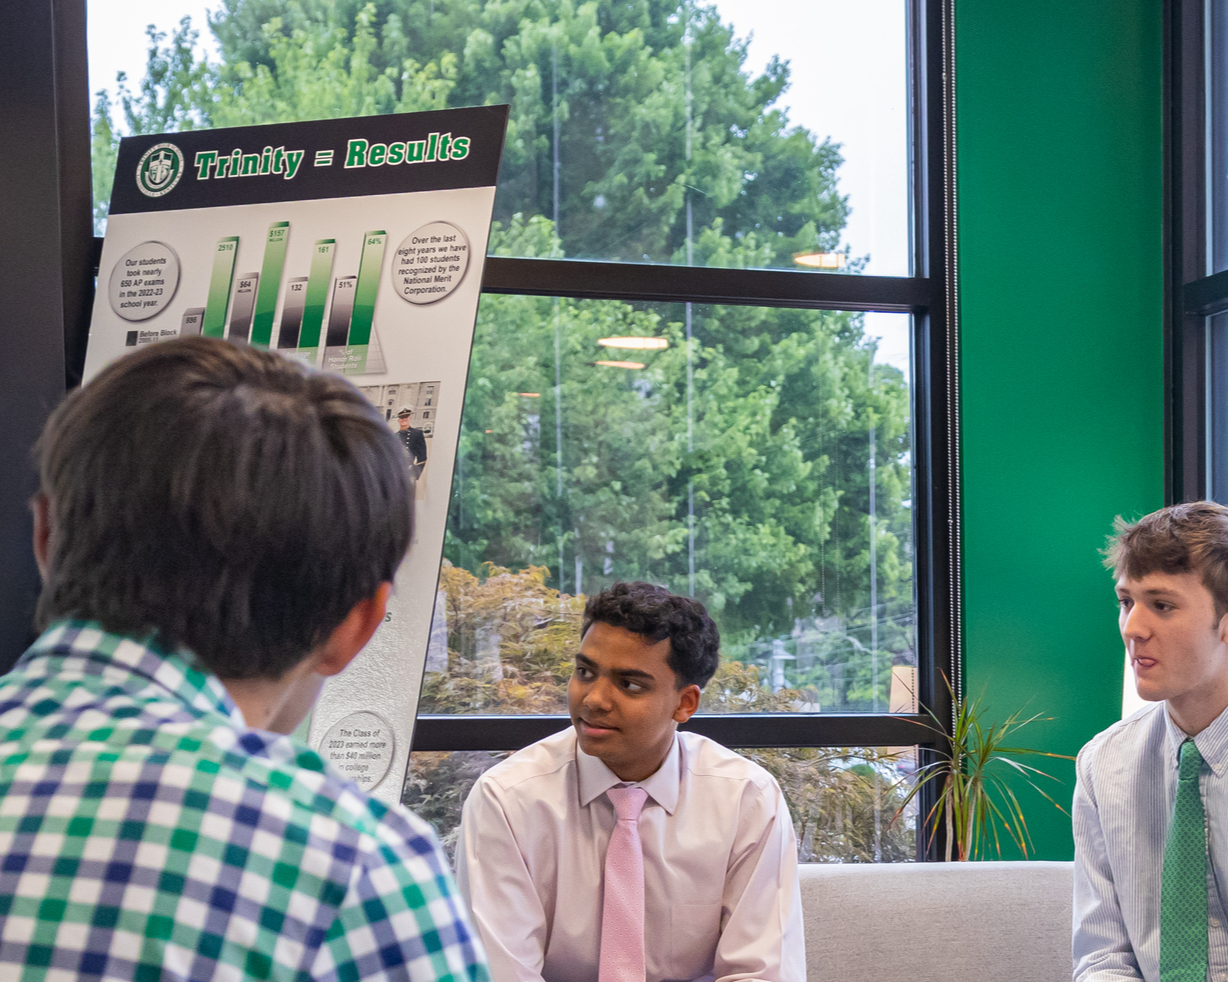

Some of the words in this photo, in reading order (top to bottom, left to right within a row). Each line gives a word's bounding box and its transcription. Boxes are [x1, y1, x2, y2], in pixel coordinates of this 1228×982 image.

[194, 145, 305, 180] Trinity
[314, 150, 334, 167] =
[344, 132, 471, 169] Results
[411, 236, 429, 245] Over
[430, 235, 442, 243] the
[443, 234, 456, 242] last
[218, 243, 234, 252] 2510
[398, 248, 416, 257] eight
[417, 246, 436, 256] years
[125, 258, 138, 267] Our
[138, 257, 167, 266] students
[401, 257, 414, 265] had
[416, 256, 428, 264] 100
[429, 255, 460, 263] students
[126, 269, 141, 277] took
[142, 268, 162, 276] nearly
[398, 265, 437, 276] recognized
[438, 265, 447, 274] by
[448, 264, 460, 272] the
[133, 279, 143, 287] AP
[338, 281, 353, 289] 51%
[403, 276, 432, 285] National
[126, 290, 137, 298] the
[138, 288, 163, 297] 2022-23
[403, 285, 447, 295] Corporation.
[120, 300, 142, 308] school
[143, 300, 159, 308] year.
[340, 729, 352, 737] The
[353, 729, 371, 737] Class
[372, 728, 381, 737] of
[328, 740, 345, 749] 2023
[345, 740, 368, 749] earned
[369, 741, 387, 749] more
[329, 752, 345, 760] than
[358, 751, 381, 760] million
[345, 763, 369, 773] college
